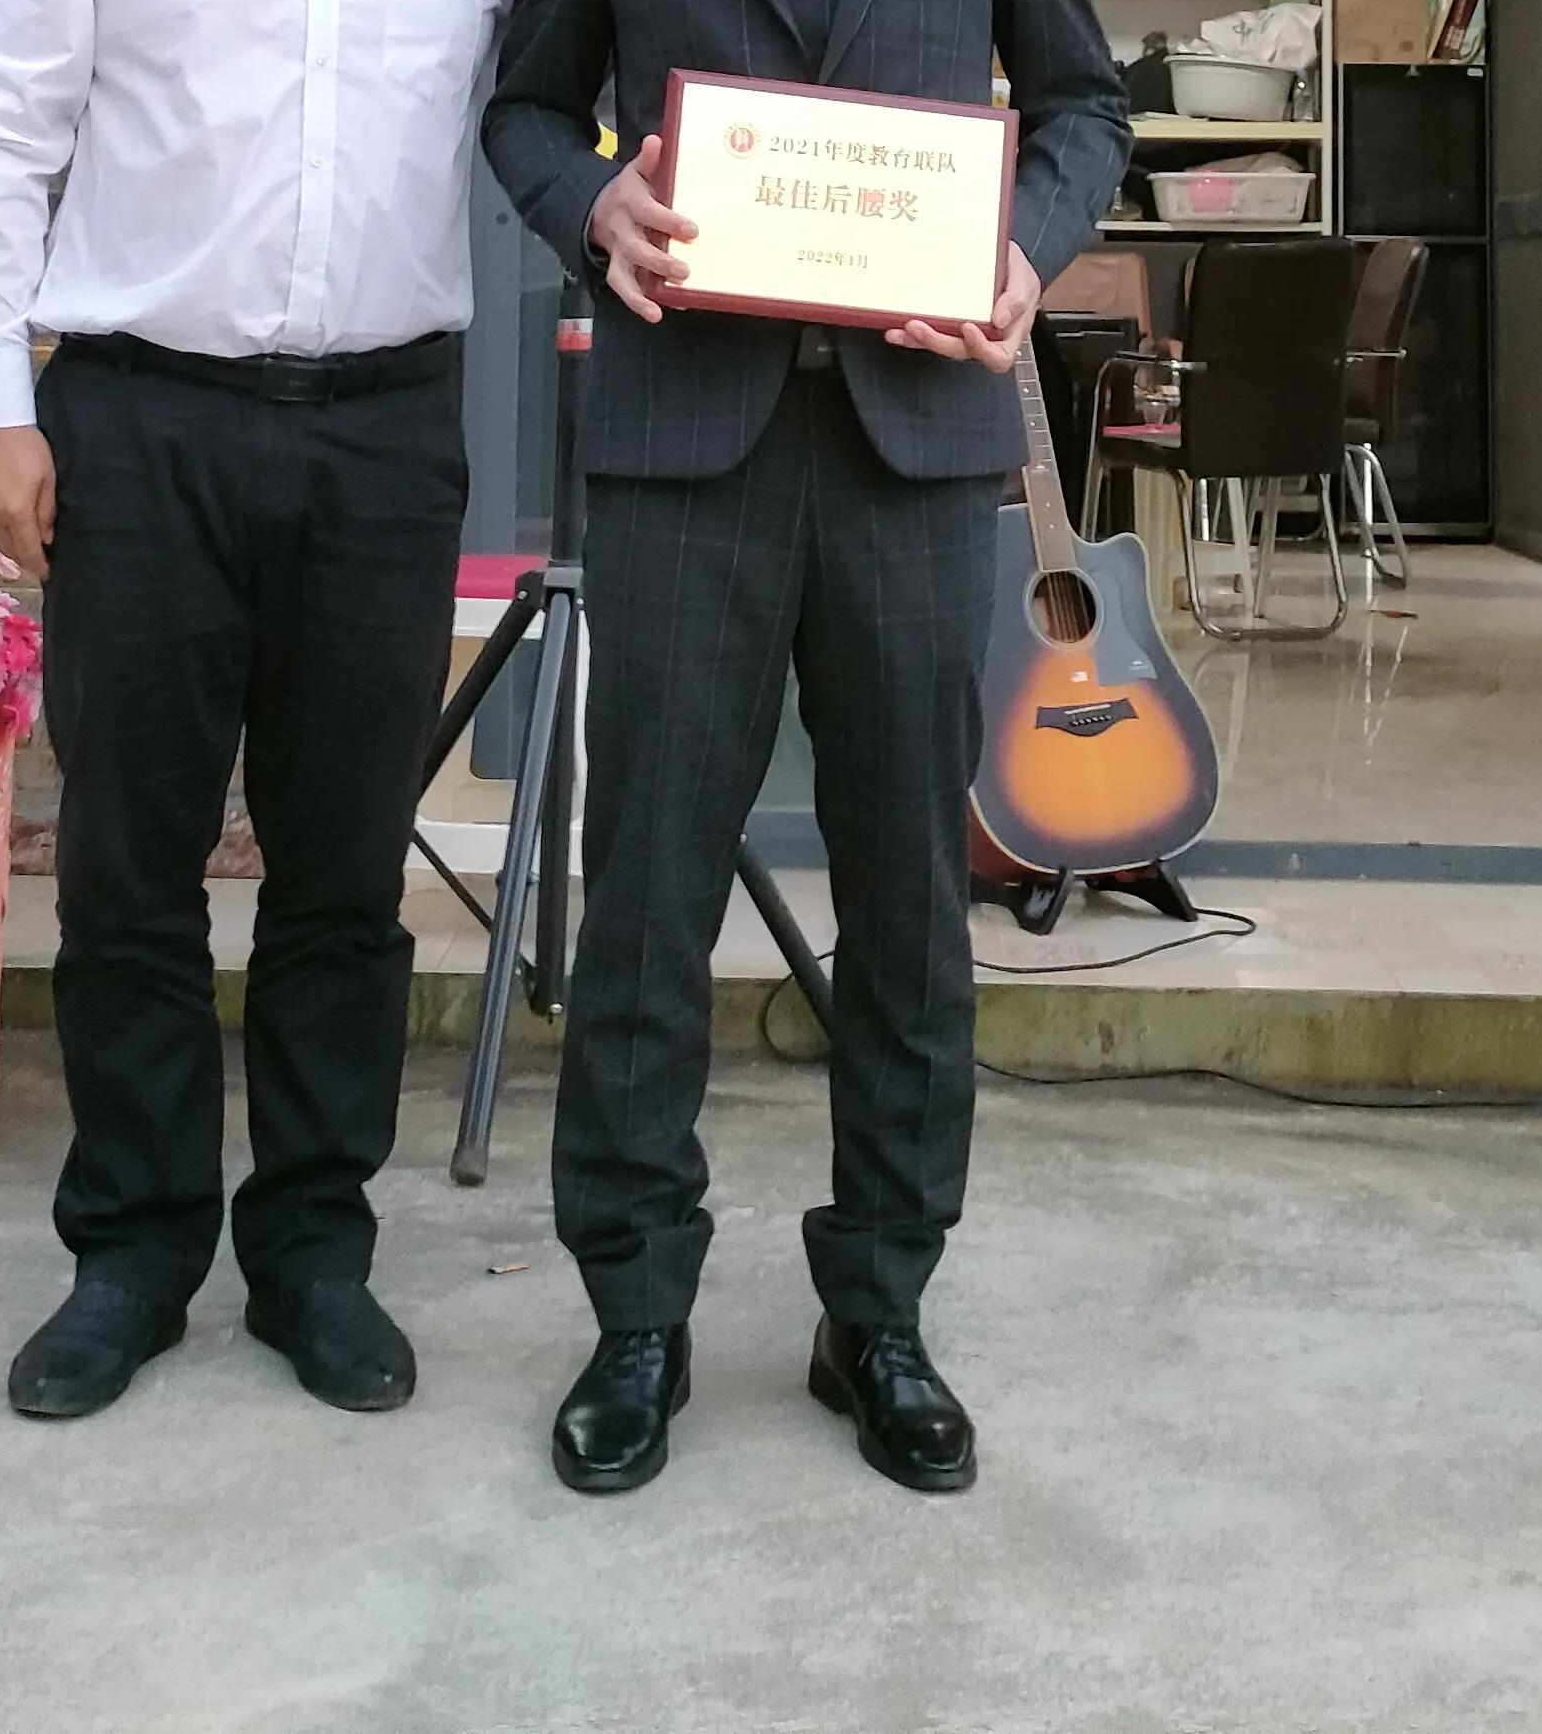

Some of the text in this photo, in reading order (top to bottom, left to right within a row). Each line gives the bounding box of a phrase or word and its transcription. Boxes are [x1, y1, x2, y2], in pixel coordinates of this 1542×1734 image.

[768, 135, 957, 174] 2021年度教育联队
[755, 175, 920, 222] 最佳后腰奖
[797, 249, 869, 269] 2022年1月
